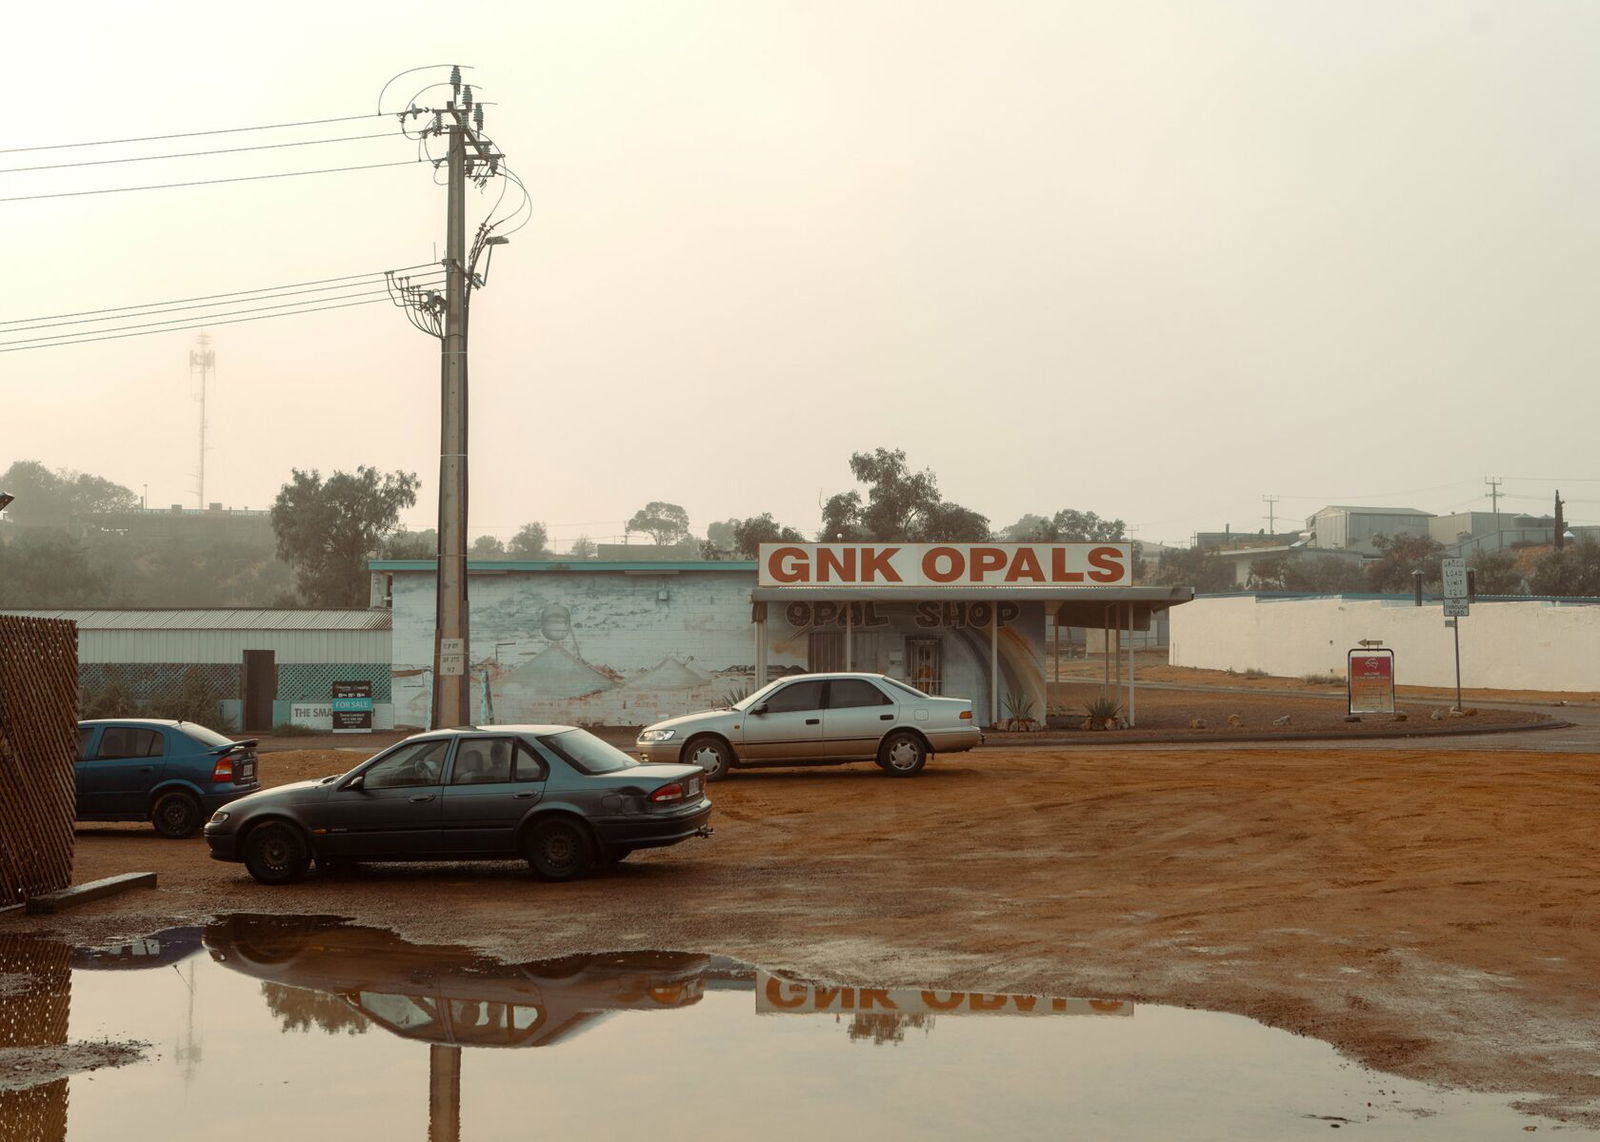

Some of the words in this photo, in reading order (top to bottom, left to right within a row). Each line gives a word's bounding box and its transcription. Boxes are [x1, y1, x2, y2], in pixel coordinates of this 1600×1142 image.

[767, 546, 904, 583] GNK
[921, 546, 1126, 583] OPALS
[786, 600, 890, 627] OPAL
[914, 600, 1020, 628] SHOP
[294, 707, 310, 717] THE
[313, 707, 334, 717] SMA
[335, 701, 350, 709] FOR
[352, 700, 369, 708] SALE
